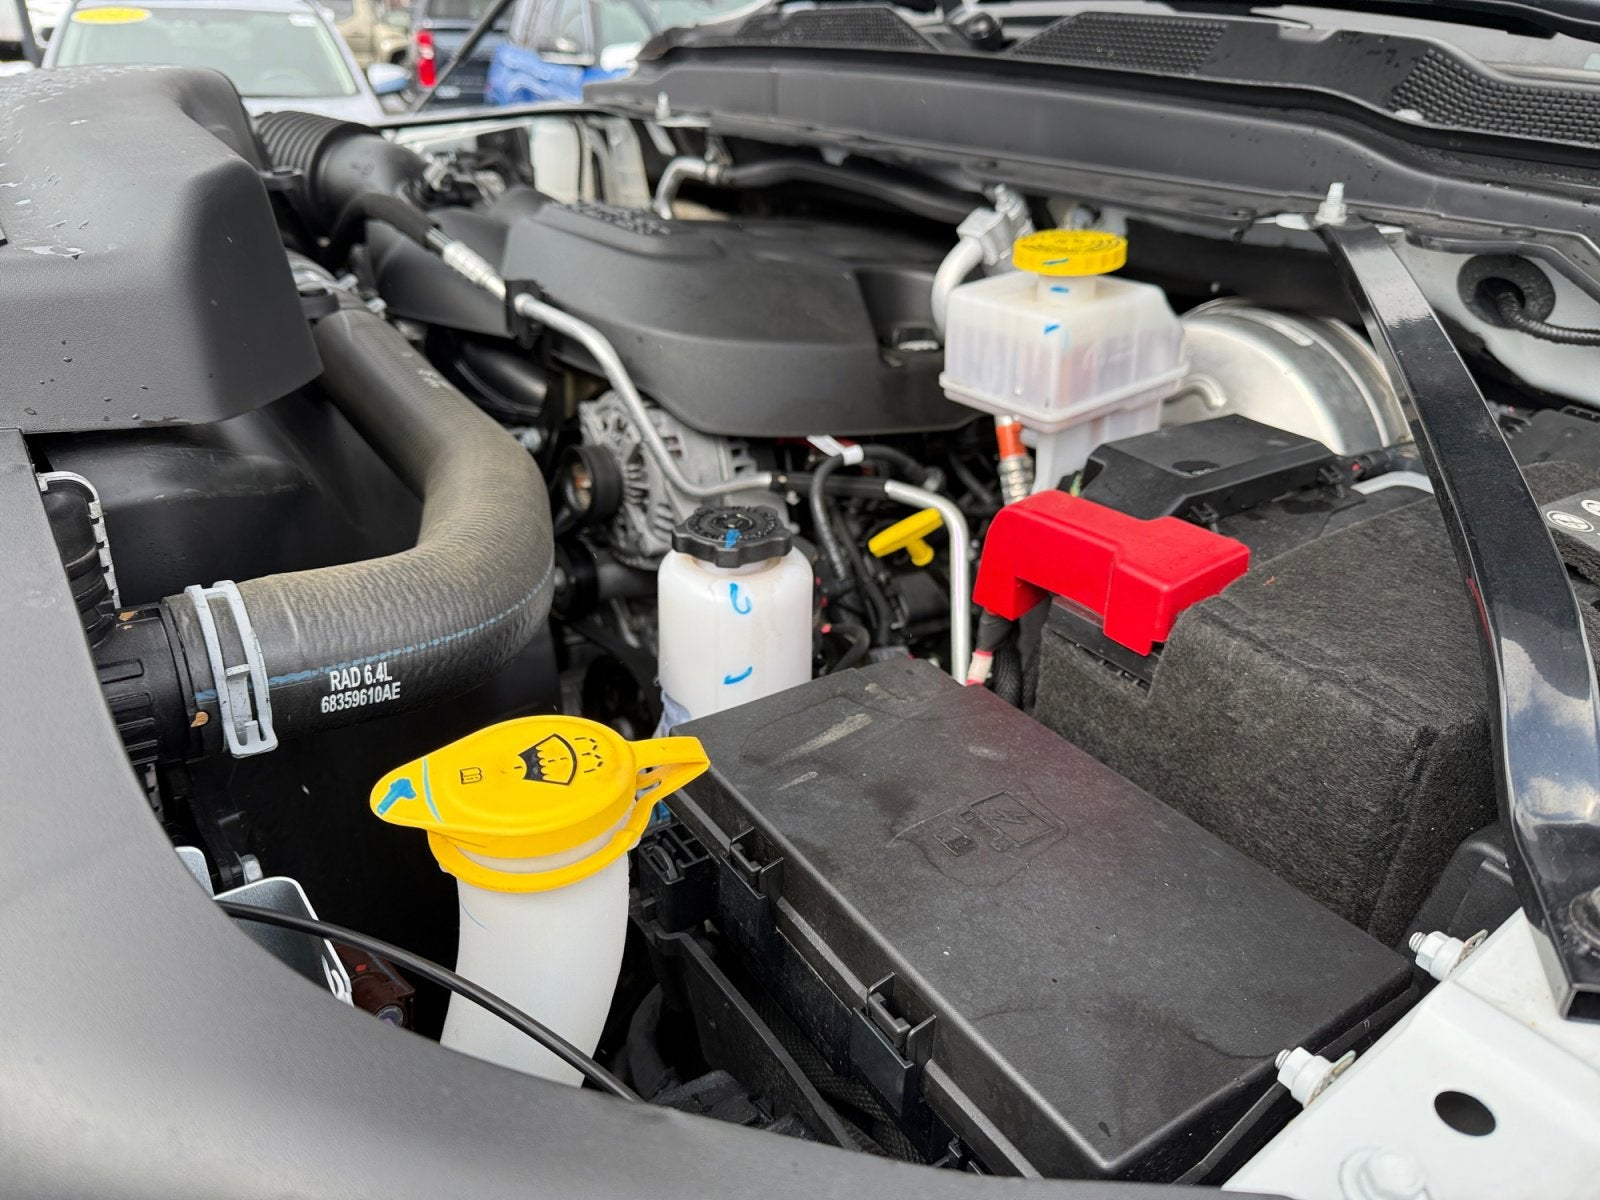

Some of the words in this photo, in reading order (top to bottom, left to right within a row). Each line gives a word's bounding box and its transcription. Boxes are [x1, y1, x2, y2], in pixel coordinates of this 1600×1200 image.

[329, 666, 361, 691] RAD
[364, 661, 393, 686] 6.4L
[321, 681, 401, 713] 68359610AE
